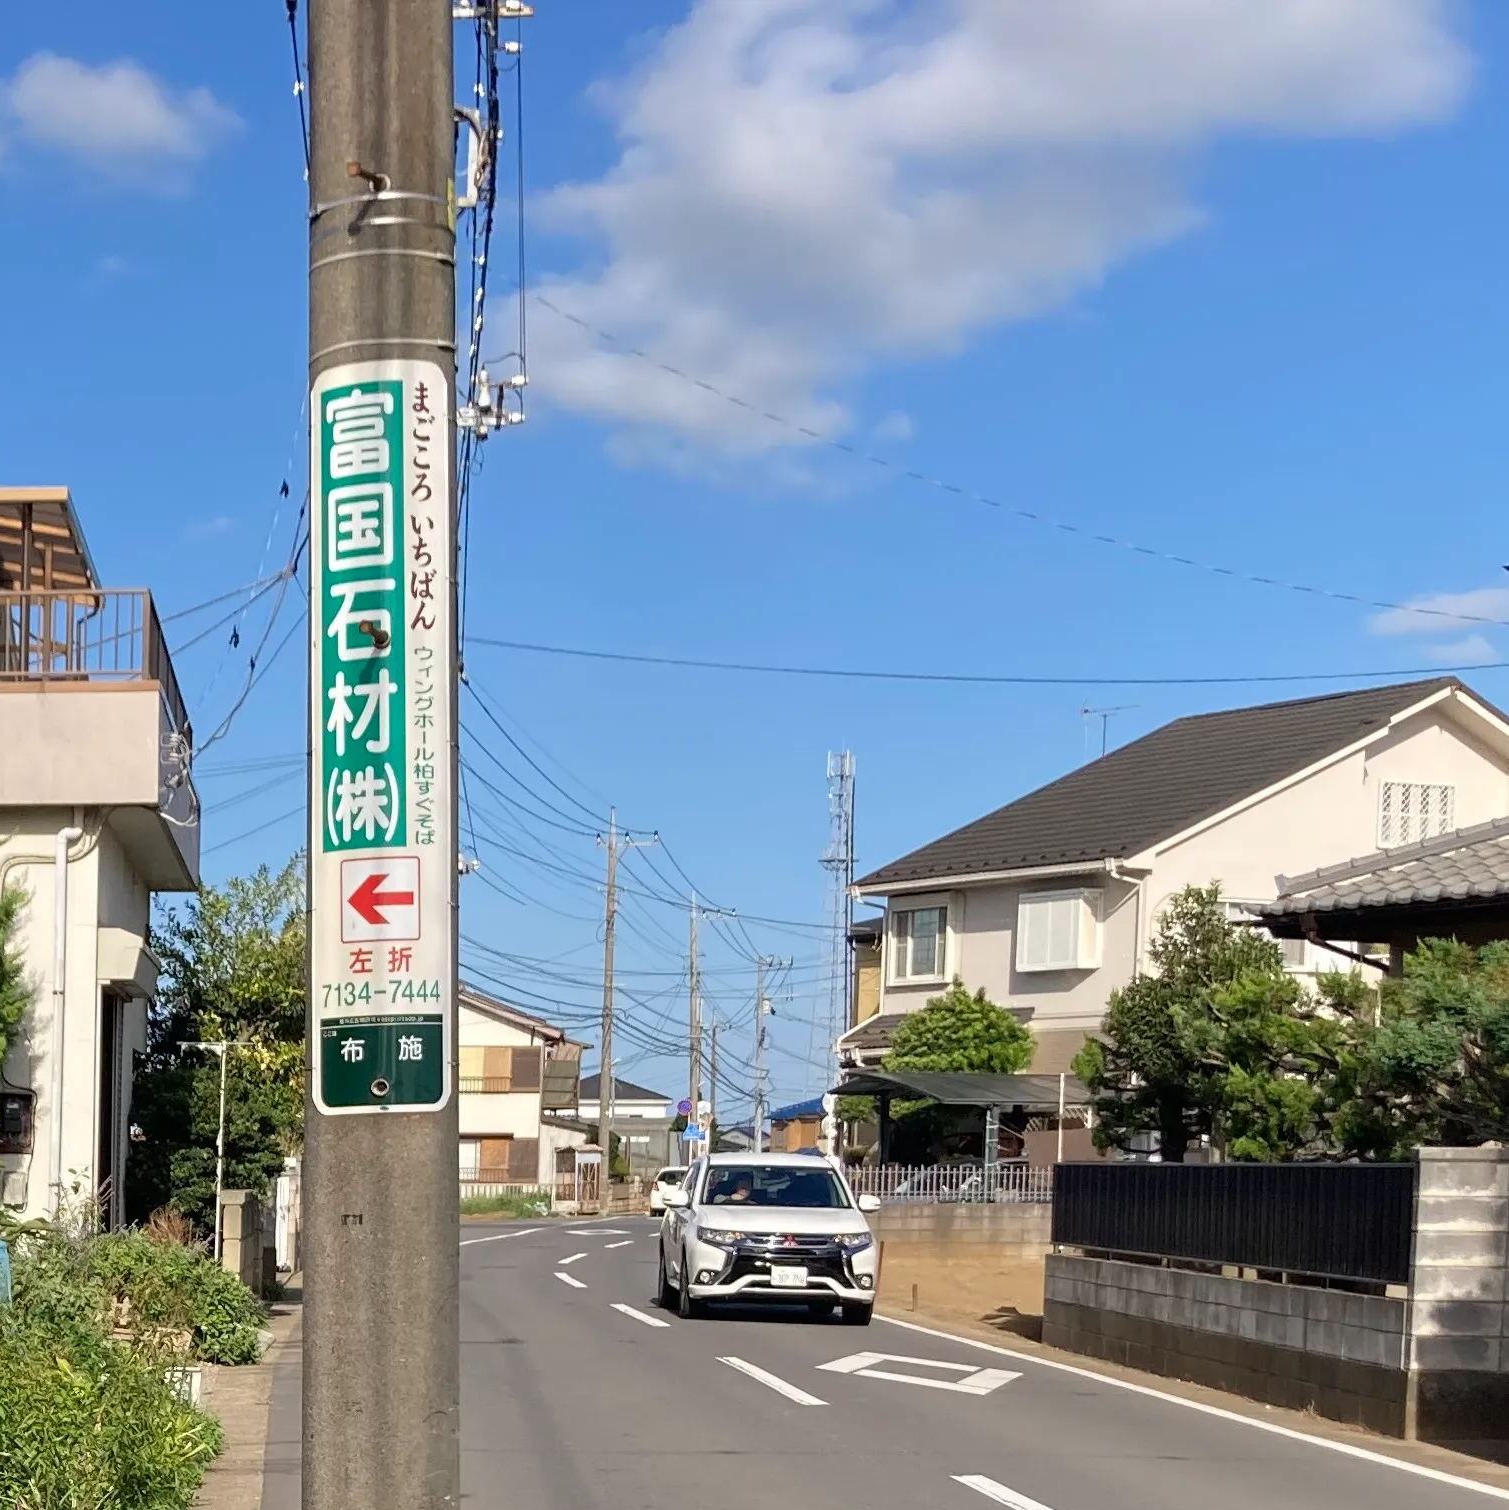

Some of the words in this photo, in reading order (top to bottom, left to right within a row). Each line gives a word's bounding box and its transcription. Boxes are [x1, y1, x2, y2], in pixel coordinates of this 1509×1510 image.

[411, 381, 435, 501] まごころ
[410, 514, 437, 630] いちばん
[349, 946, 412, 974] 左折
[322, 979, 440, 1008] 7134-7444
[340, 1034, 423, 1063] 布施
